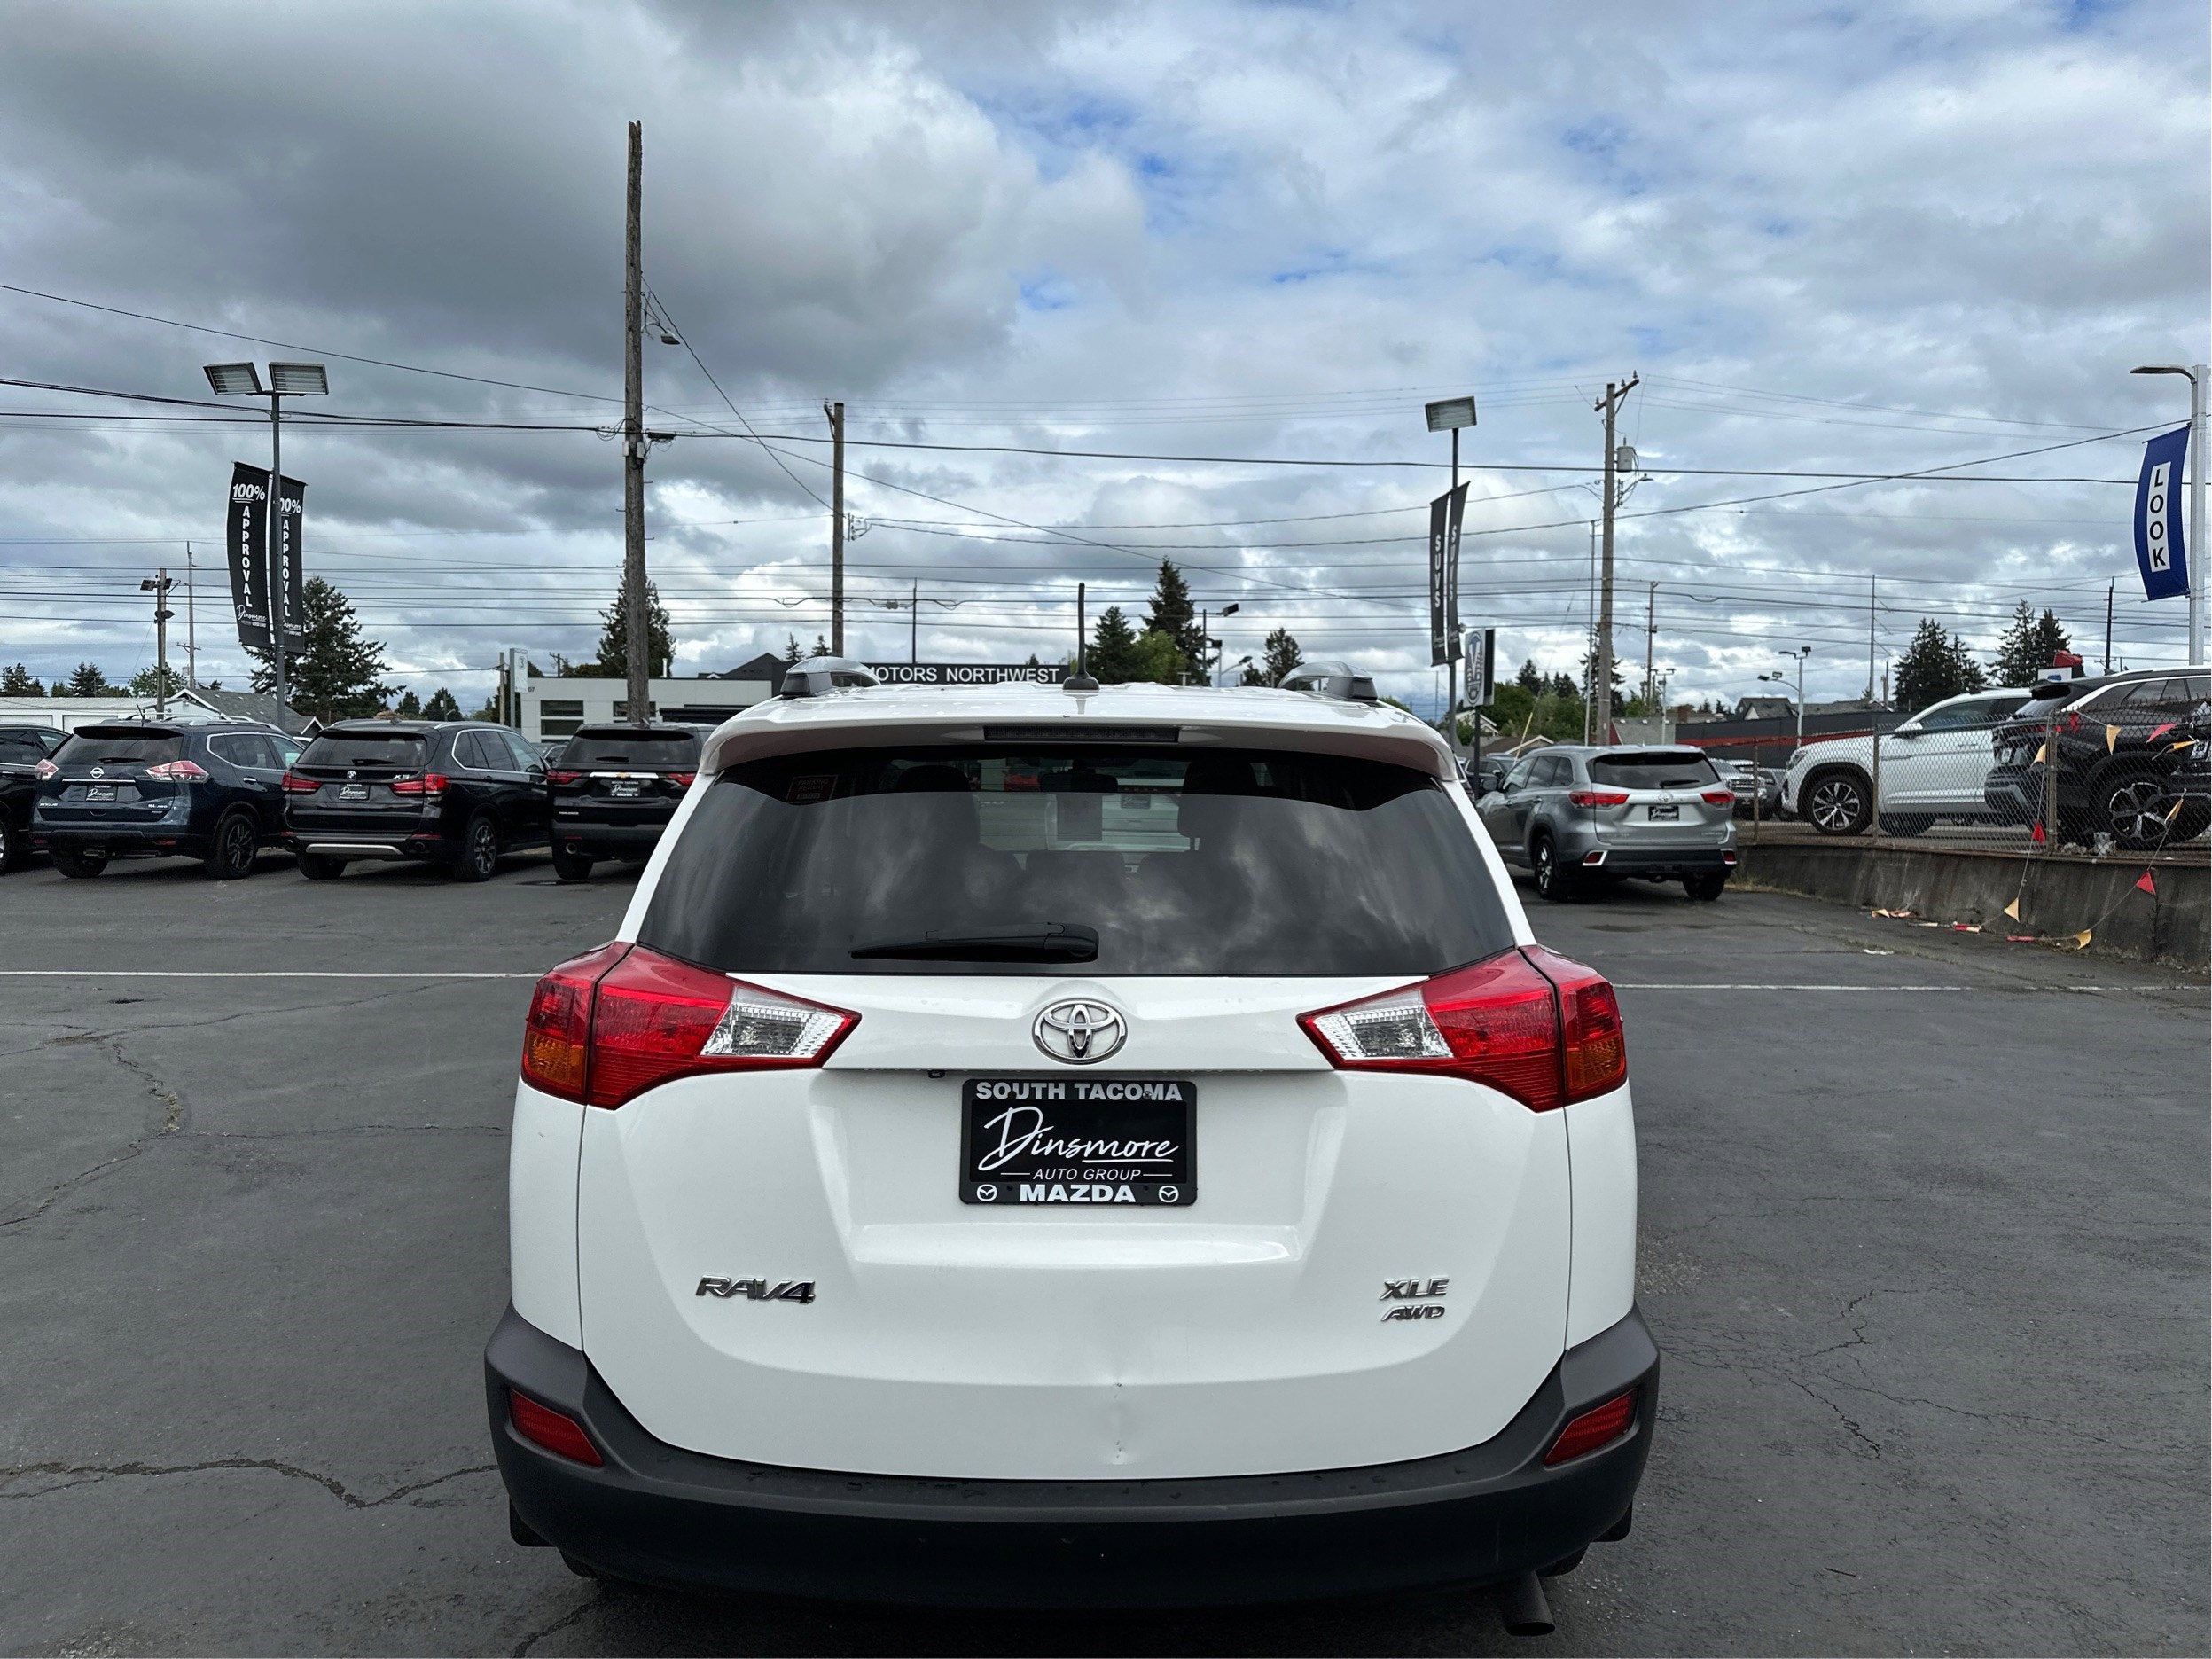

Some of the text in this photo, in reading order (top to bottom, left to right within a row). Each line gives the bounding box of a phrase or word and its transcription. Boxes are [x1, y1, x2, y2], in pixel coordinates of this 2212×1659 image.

[232, 484, 265, 501] 100%
[280, 497, 301, 514] 00%
[2150, 469, 2166, 567] LOOK
[241, 505, 253, 608] APPROVAL
[282, 520, 291, 616] APPROVAL
[946, 668, 1060, 683] NORTHWEST
[976, 1082, 1183, 1101] SOUTH TACOMA
[978, 1106, 1180, 1171] Dinsmore
[1033, 1169, 1142, 1181] AUTO GROUP
[1020, 1184, 1137, 1203] MAZDA
[695, 1275, 817, 1305] RAV4
[1380, 1277, 1450, 1301] XLE
[1380, 1304, 1446, 1322] AWD
